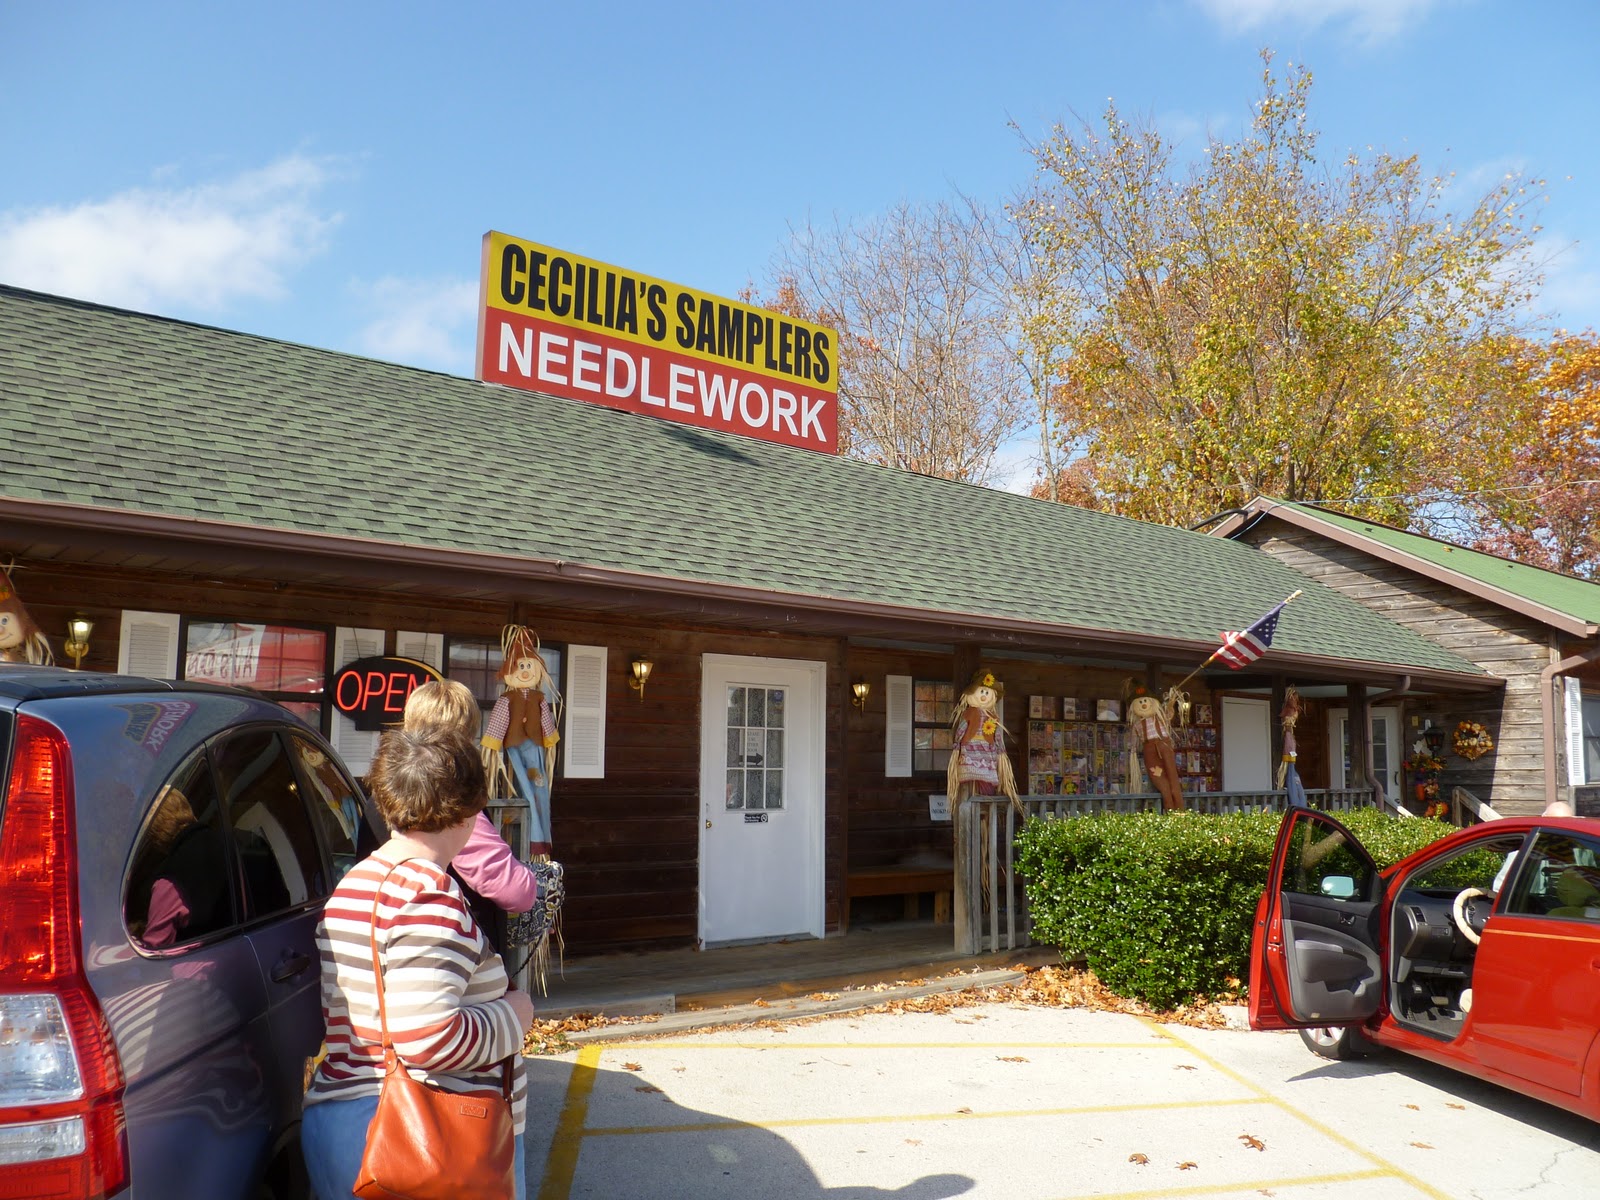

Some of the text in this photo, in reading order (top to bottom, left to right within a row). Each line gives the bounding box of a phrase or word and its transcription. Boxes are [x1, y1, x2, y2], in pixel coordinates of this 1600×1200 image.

[501, 243, 830, 384] CECILIA'S SAMPLERS
[498, 322, 827, 443] NEEDLEWORK
